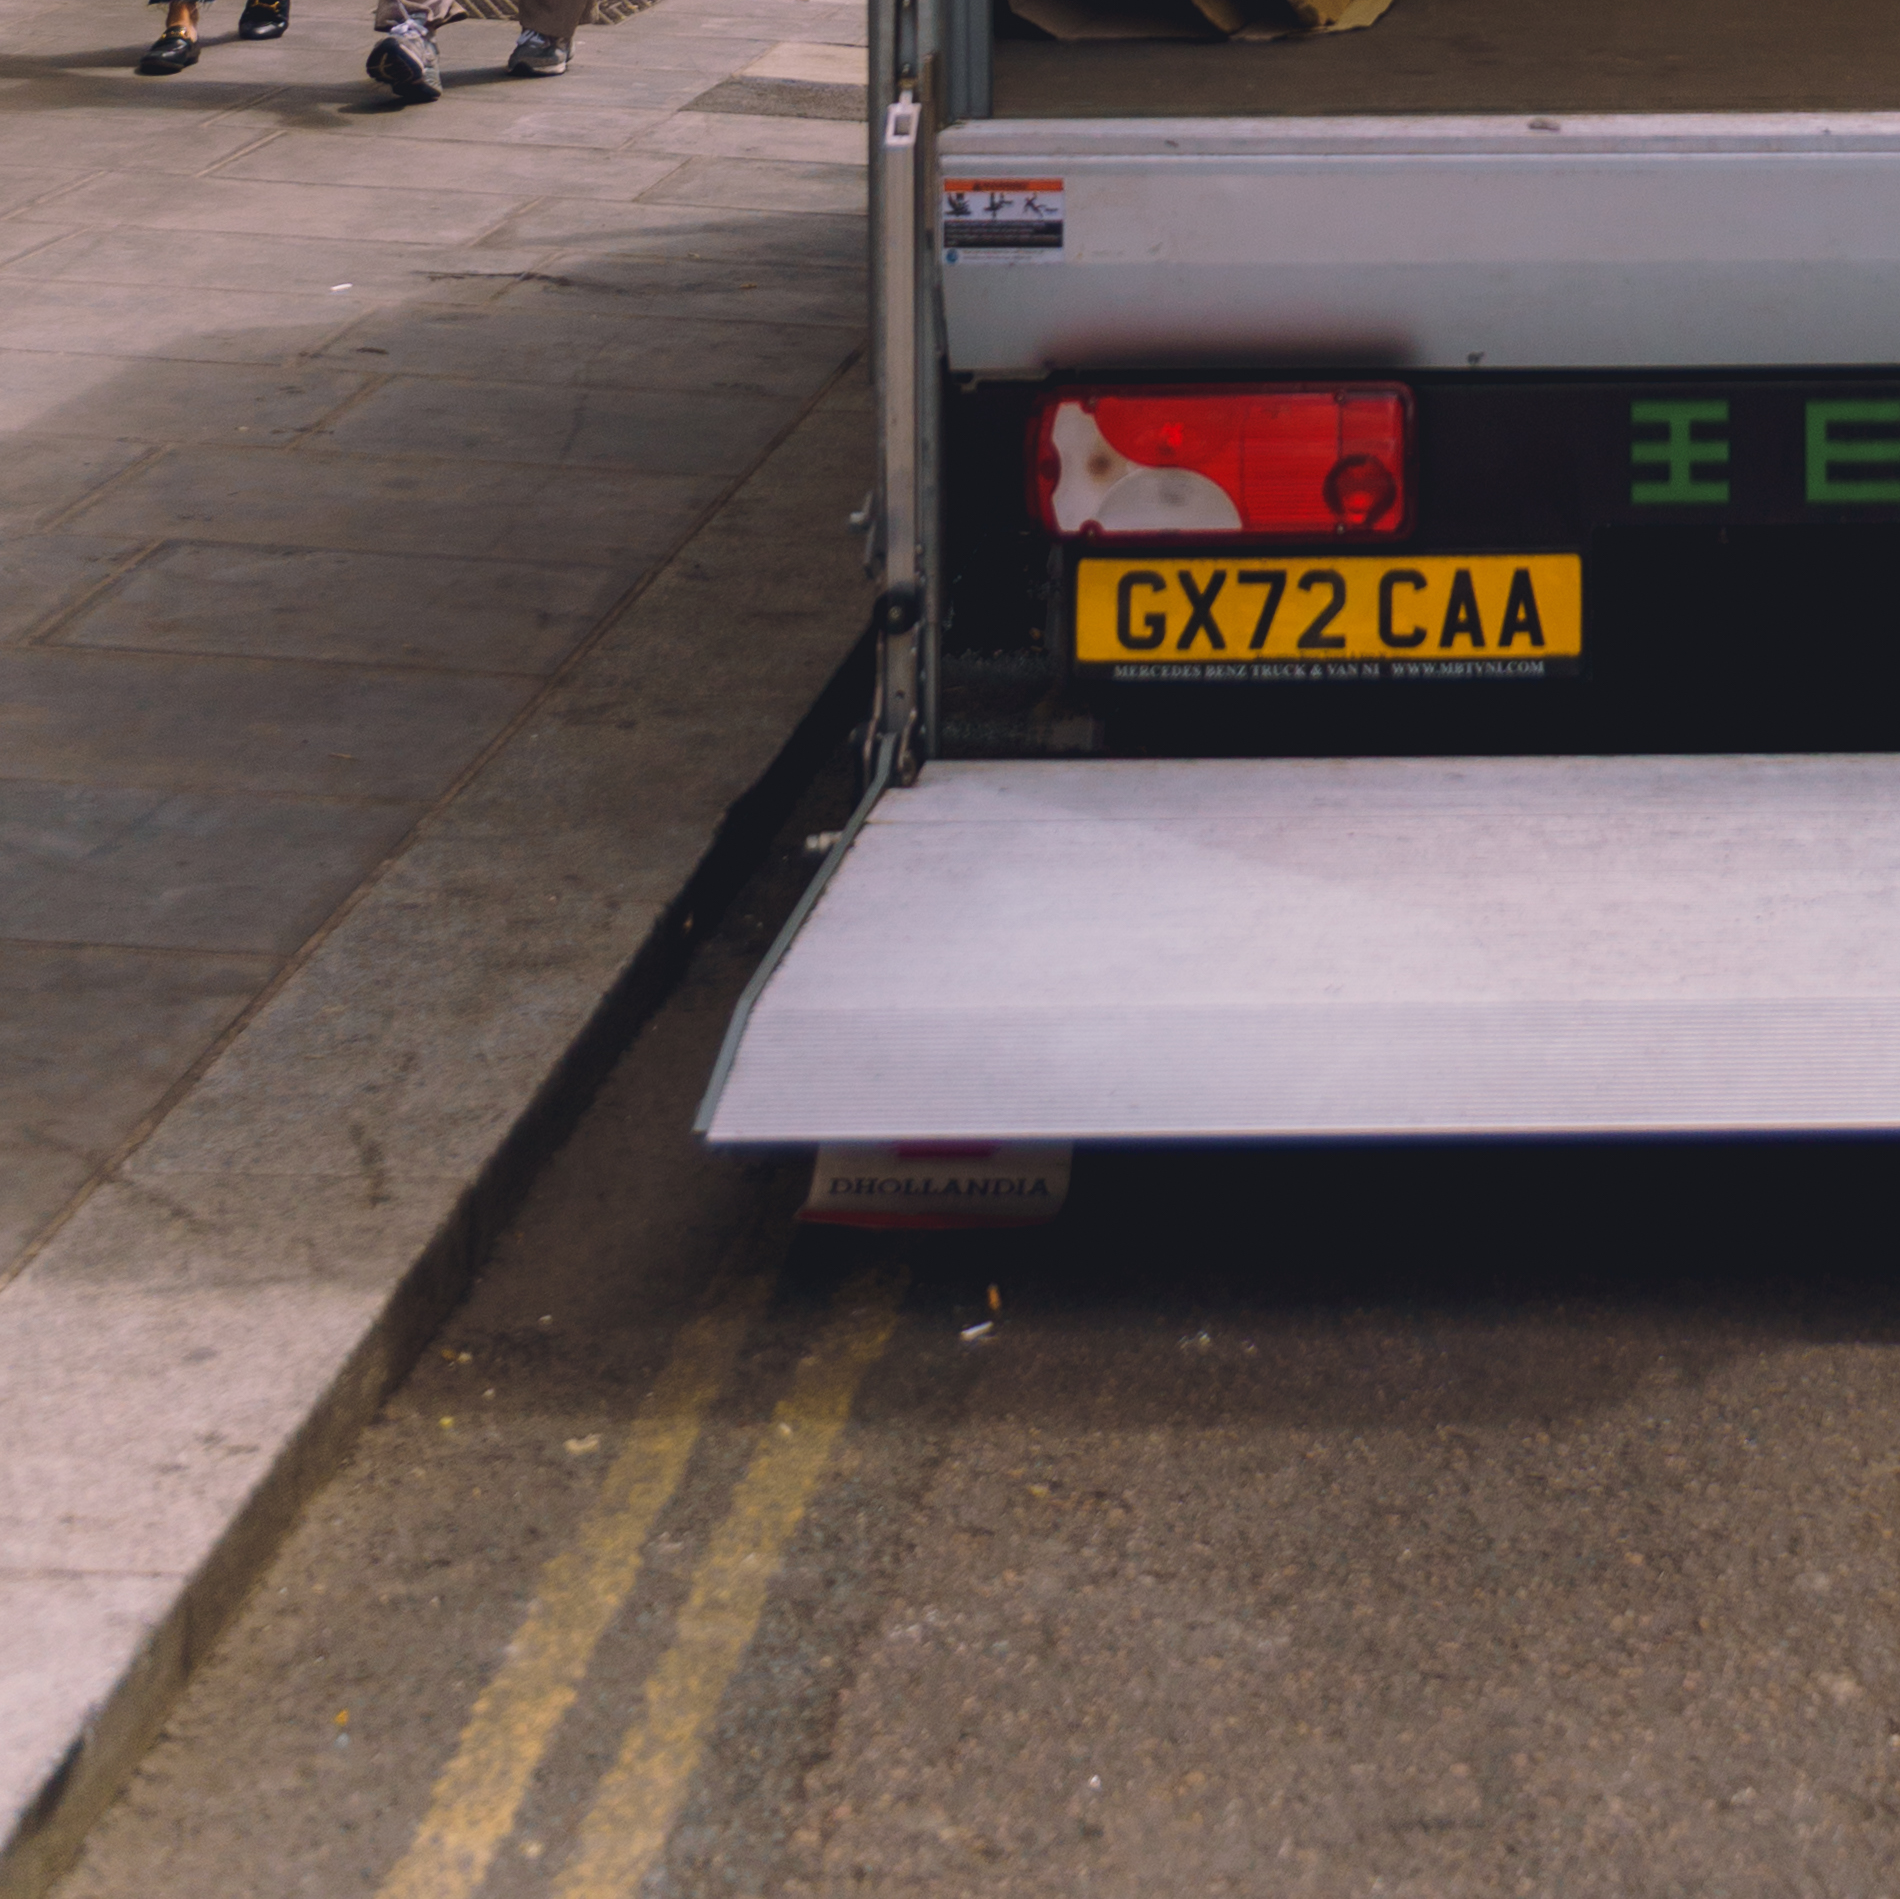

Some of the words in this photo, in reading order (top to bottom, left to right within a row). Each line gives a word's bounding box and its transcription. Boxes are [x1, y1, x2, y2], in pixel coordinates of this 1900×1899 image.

[1116, 568, 1347, 651] GX72
[1377, 567, 1546, 649] CAA
[1113, 664, 1201, 679] MERCEDES
[1204, 664, 1247, 679] BENZ
[1251, 664, 1308, 679] TRUCK
[1310, 664, 1324, 678] &
[1326, 663, 1359, 678] VAN
[829, 1177, 1050, 1197] DHOLLANDIA
